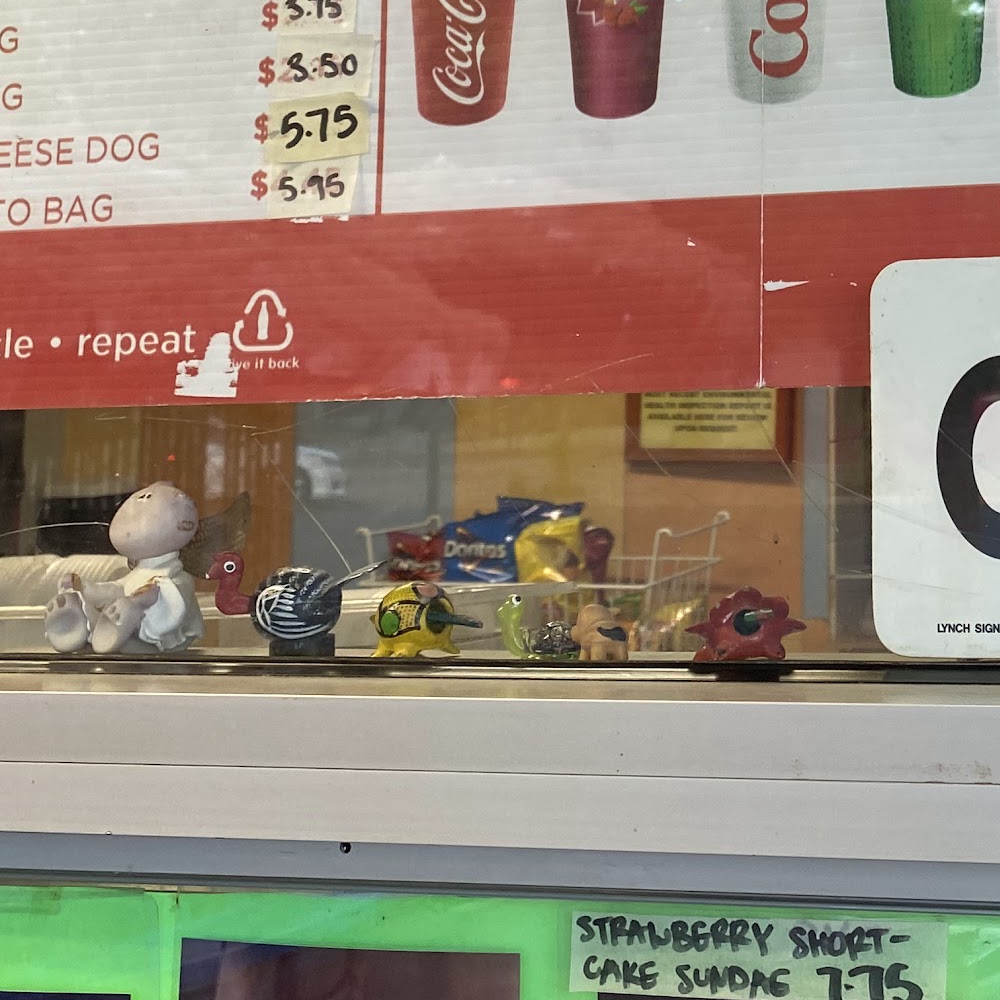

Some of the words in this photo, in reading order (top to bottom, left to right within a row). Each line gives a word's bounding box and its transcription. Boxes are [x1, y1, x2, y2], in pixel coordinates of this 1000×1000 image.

[86, 132, 160, 164] DOG
[44, 193, 113, 225] BAG
[0, 327, 33, 359] le
[77, 325, 197, 362] repeat
[268, 355, 300, 370] back
[937, 623, 971, 634] LYNCH
[974, 623, 1000, 634] SIGN
[575, 914, 774, 956] STRAWBERRY
[788, 925, 911, 962] SHORT-
[582, 955, 659, 990] CAKE
[675, 963, 791, 1000] SUNDAE
[816, 962, 924, 1000] 7.75
